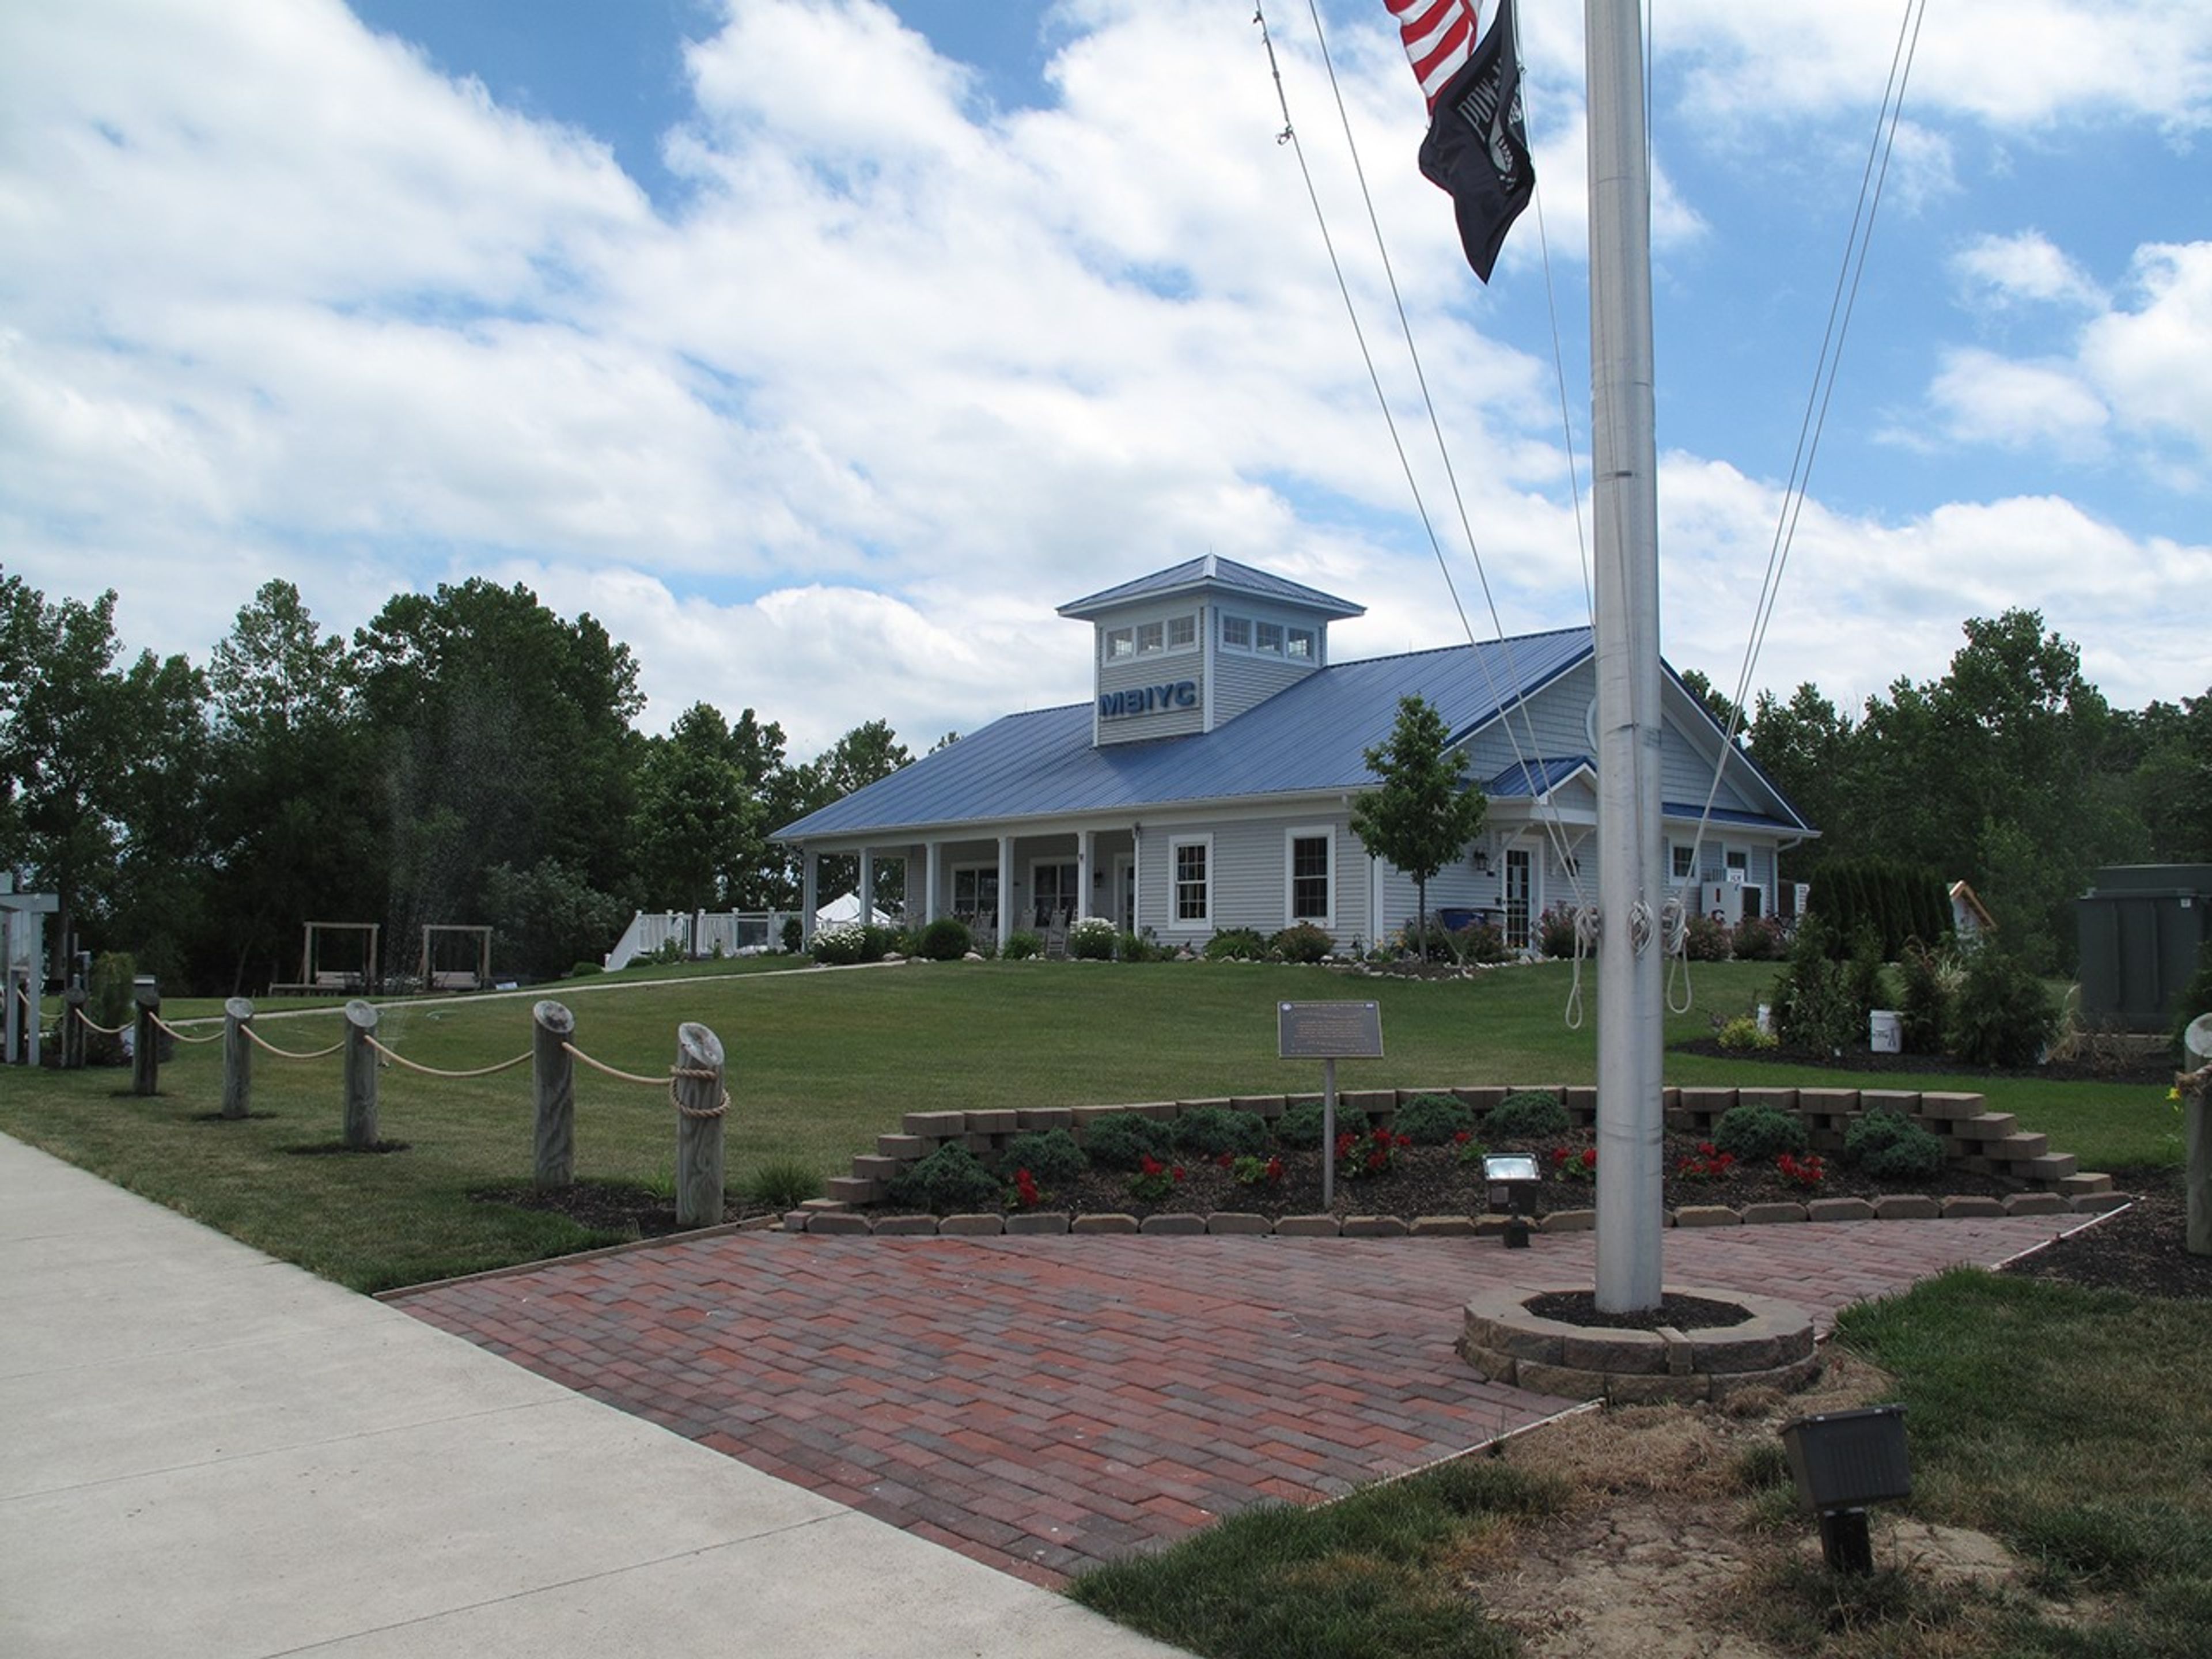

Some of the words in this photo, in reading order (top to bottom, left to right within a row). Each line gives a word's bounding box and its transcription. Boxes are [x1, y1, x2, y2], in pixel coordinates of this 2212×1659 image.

[1457, 77, 1499, 143] POW
[1099, 681, 1196, 716] MBIYC
[1711, 888, 1725, 925] IC
